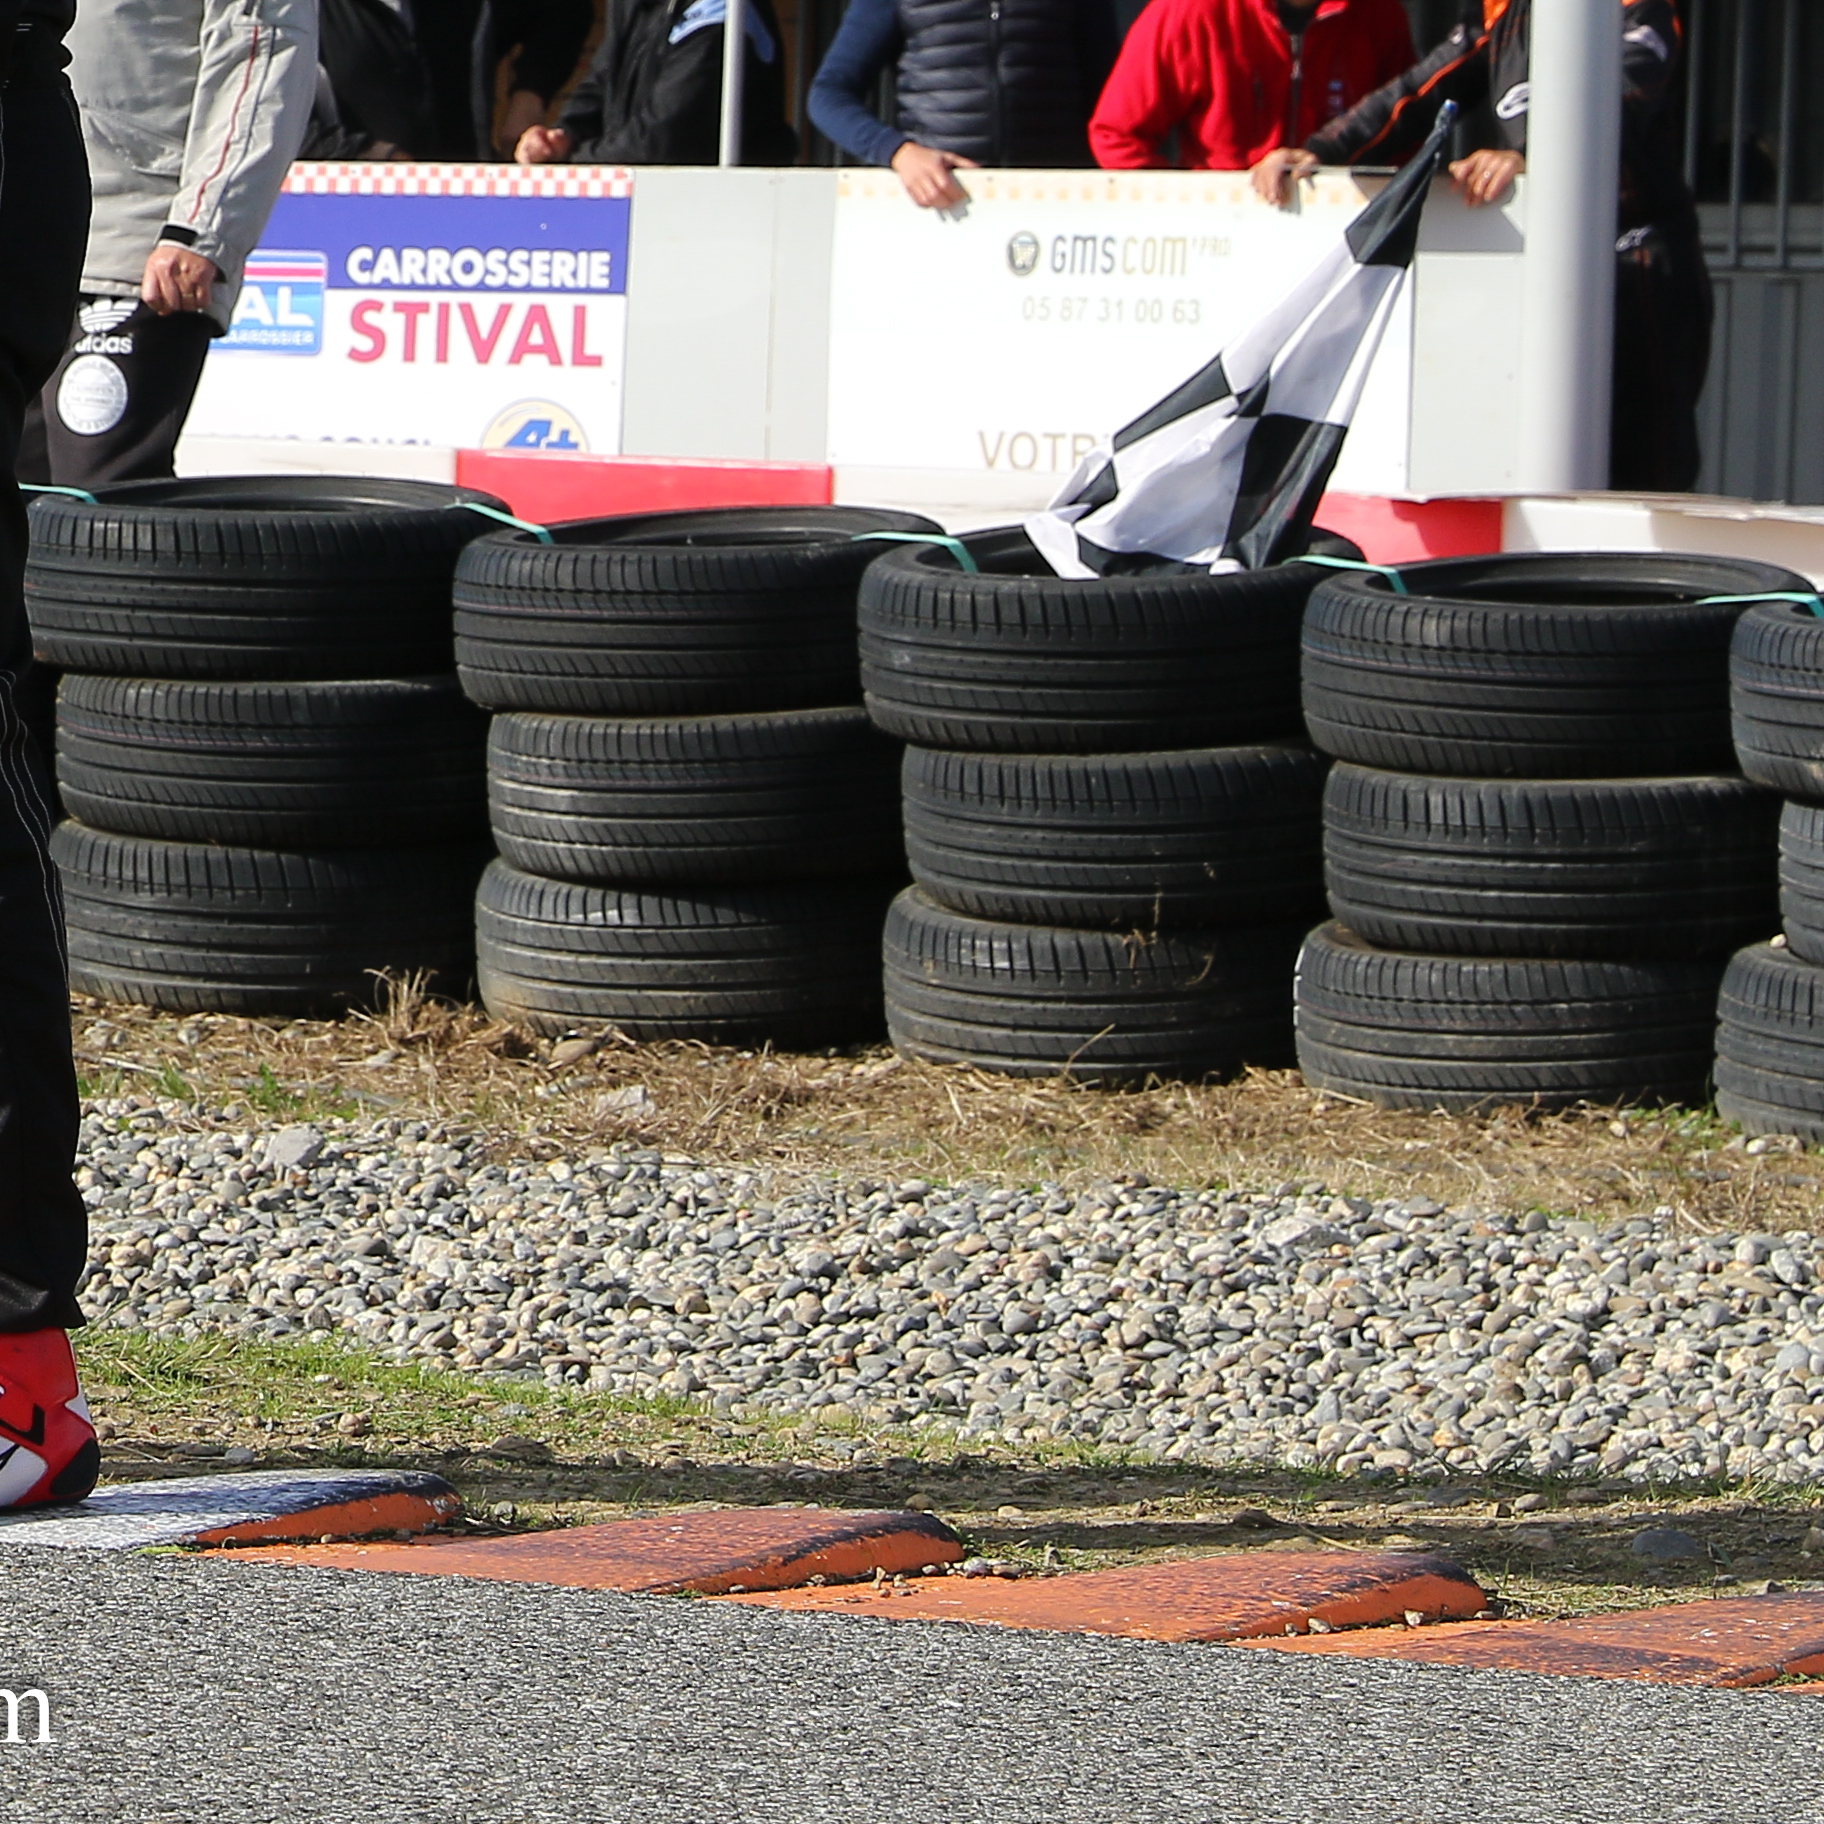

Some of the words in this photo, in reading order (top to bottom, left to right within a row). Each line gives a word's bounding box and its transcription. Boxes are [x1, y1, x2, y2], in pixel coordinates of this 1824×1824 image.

[345, 245, 612, 289] CARROSSERIE
[1021, 295, 1052, 322] 05
[1058, 296, 1089, 323] 87
[1096, 297, 1125, 323] 31
[1134, 298, 1163, 324] 00
[1172, 298, 1202, 325] 63
[347, 298, 604, 368] STIVAL
[977, 430, 1110, 471] VOTR
